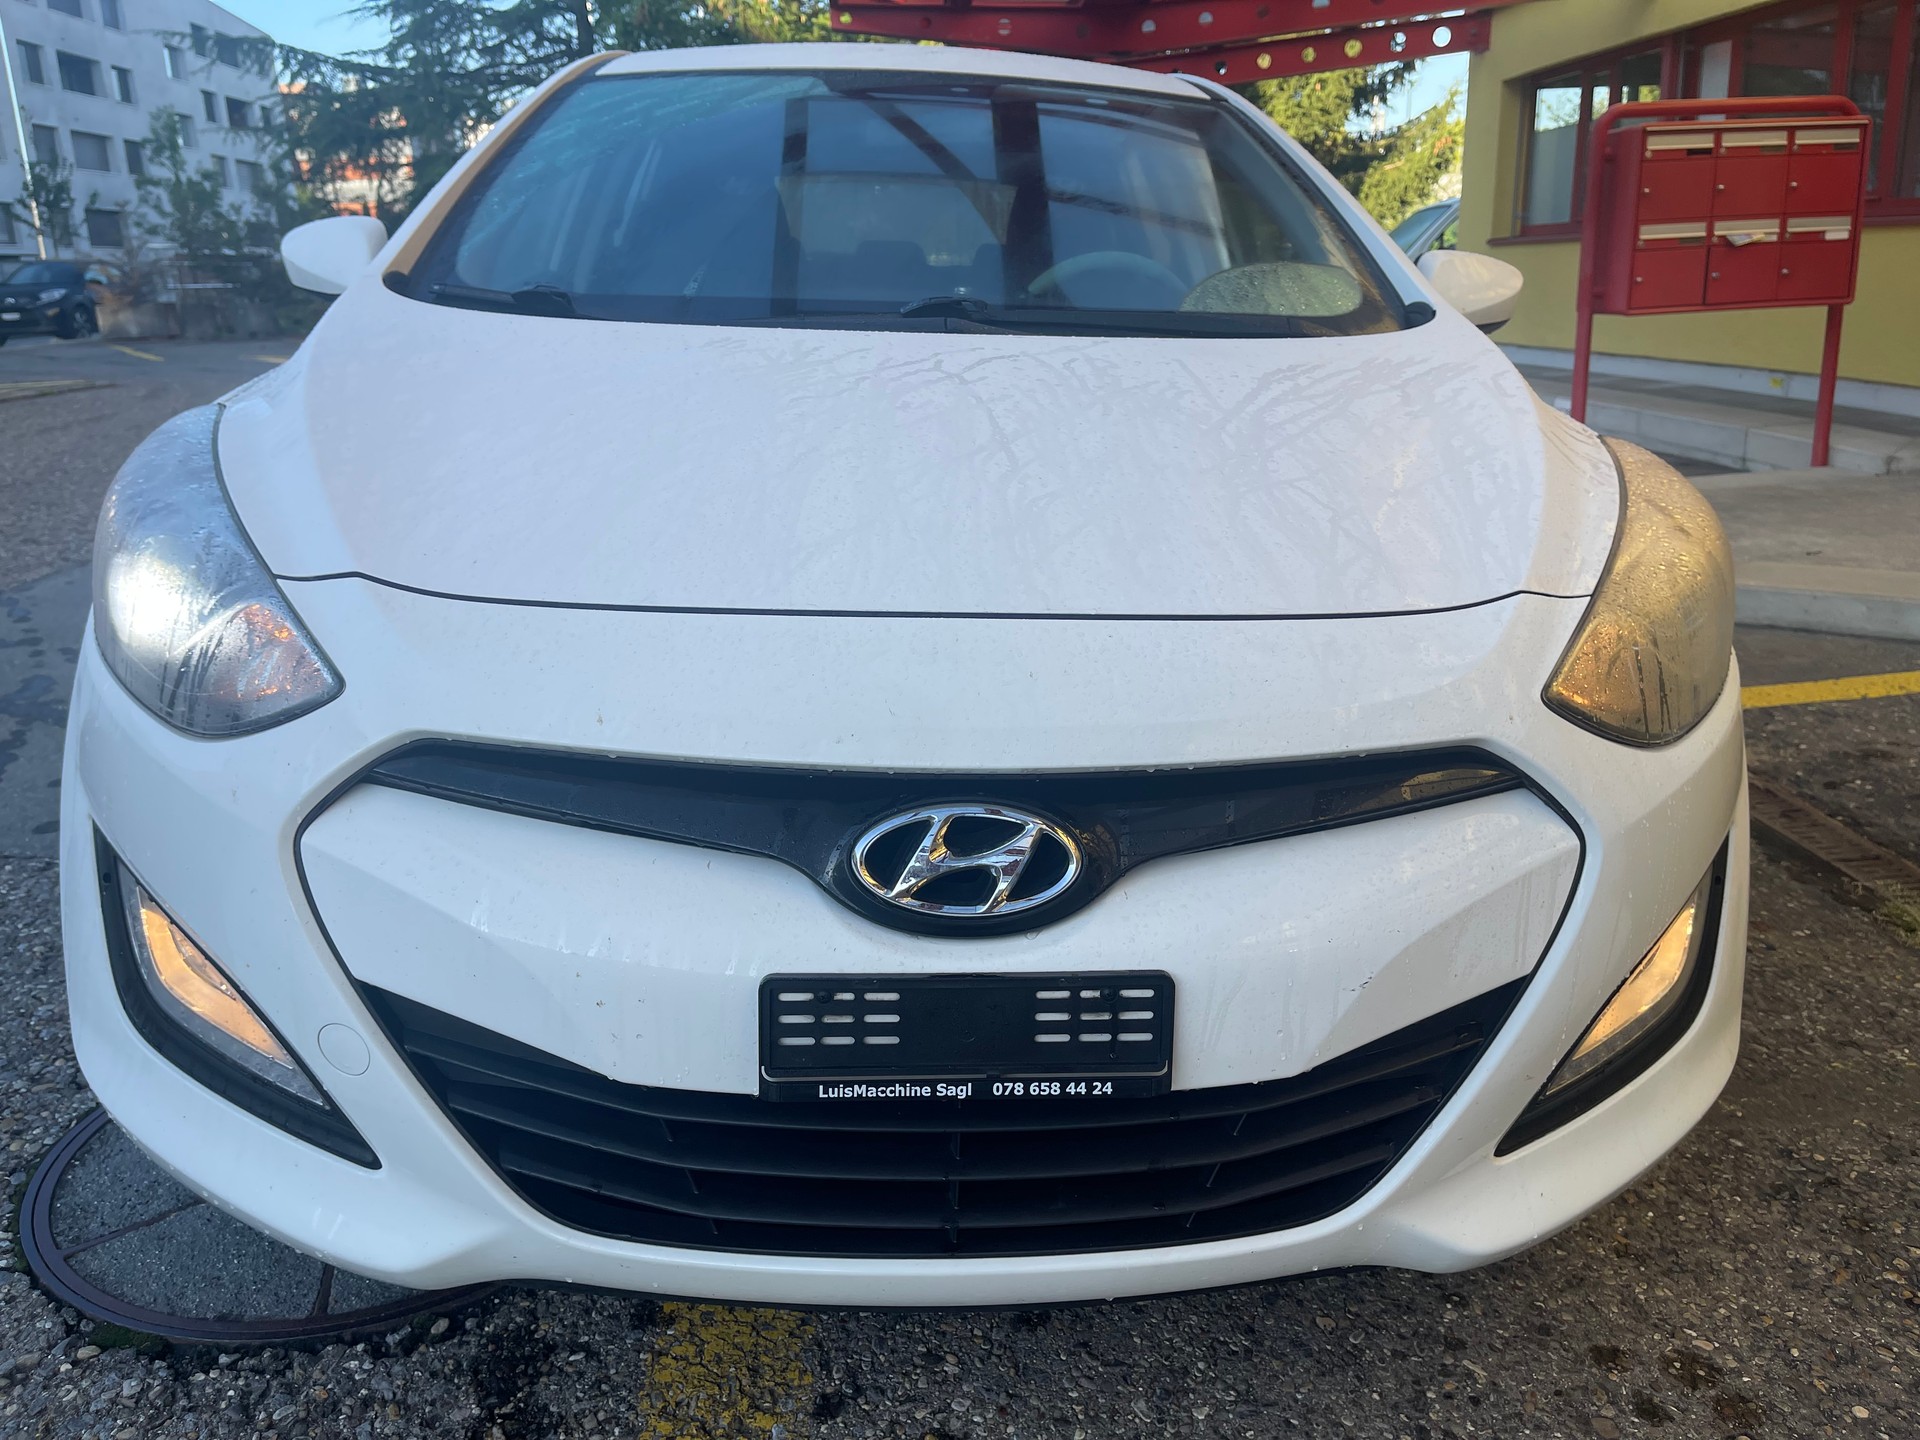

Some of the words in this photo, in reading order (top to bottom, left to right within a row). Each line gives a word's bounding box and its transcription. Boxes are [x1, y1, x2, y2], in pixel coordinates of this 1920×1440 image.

[818, 1083, 932, 1098] LuisMacchine
[936, 1082, 972, 1099] Sagl
[992, 1082, 1025, 1096] 078
[1029, 1081, 1061, 1096] 658
[1065, 1081, 1087, 1095] 44
[1092, 1081, 1113, 1095] 24
